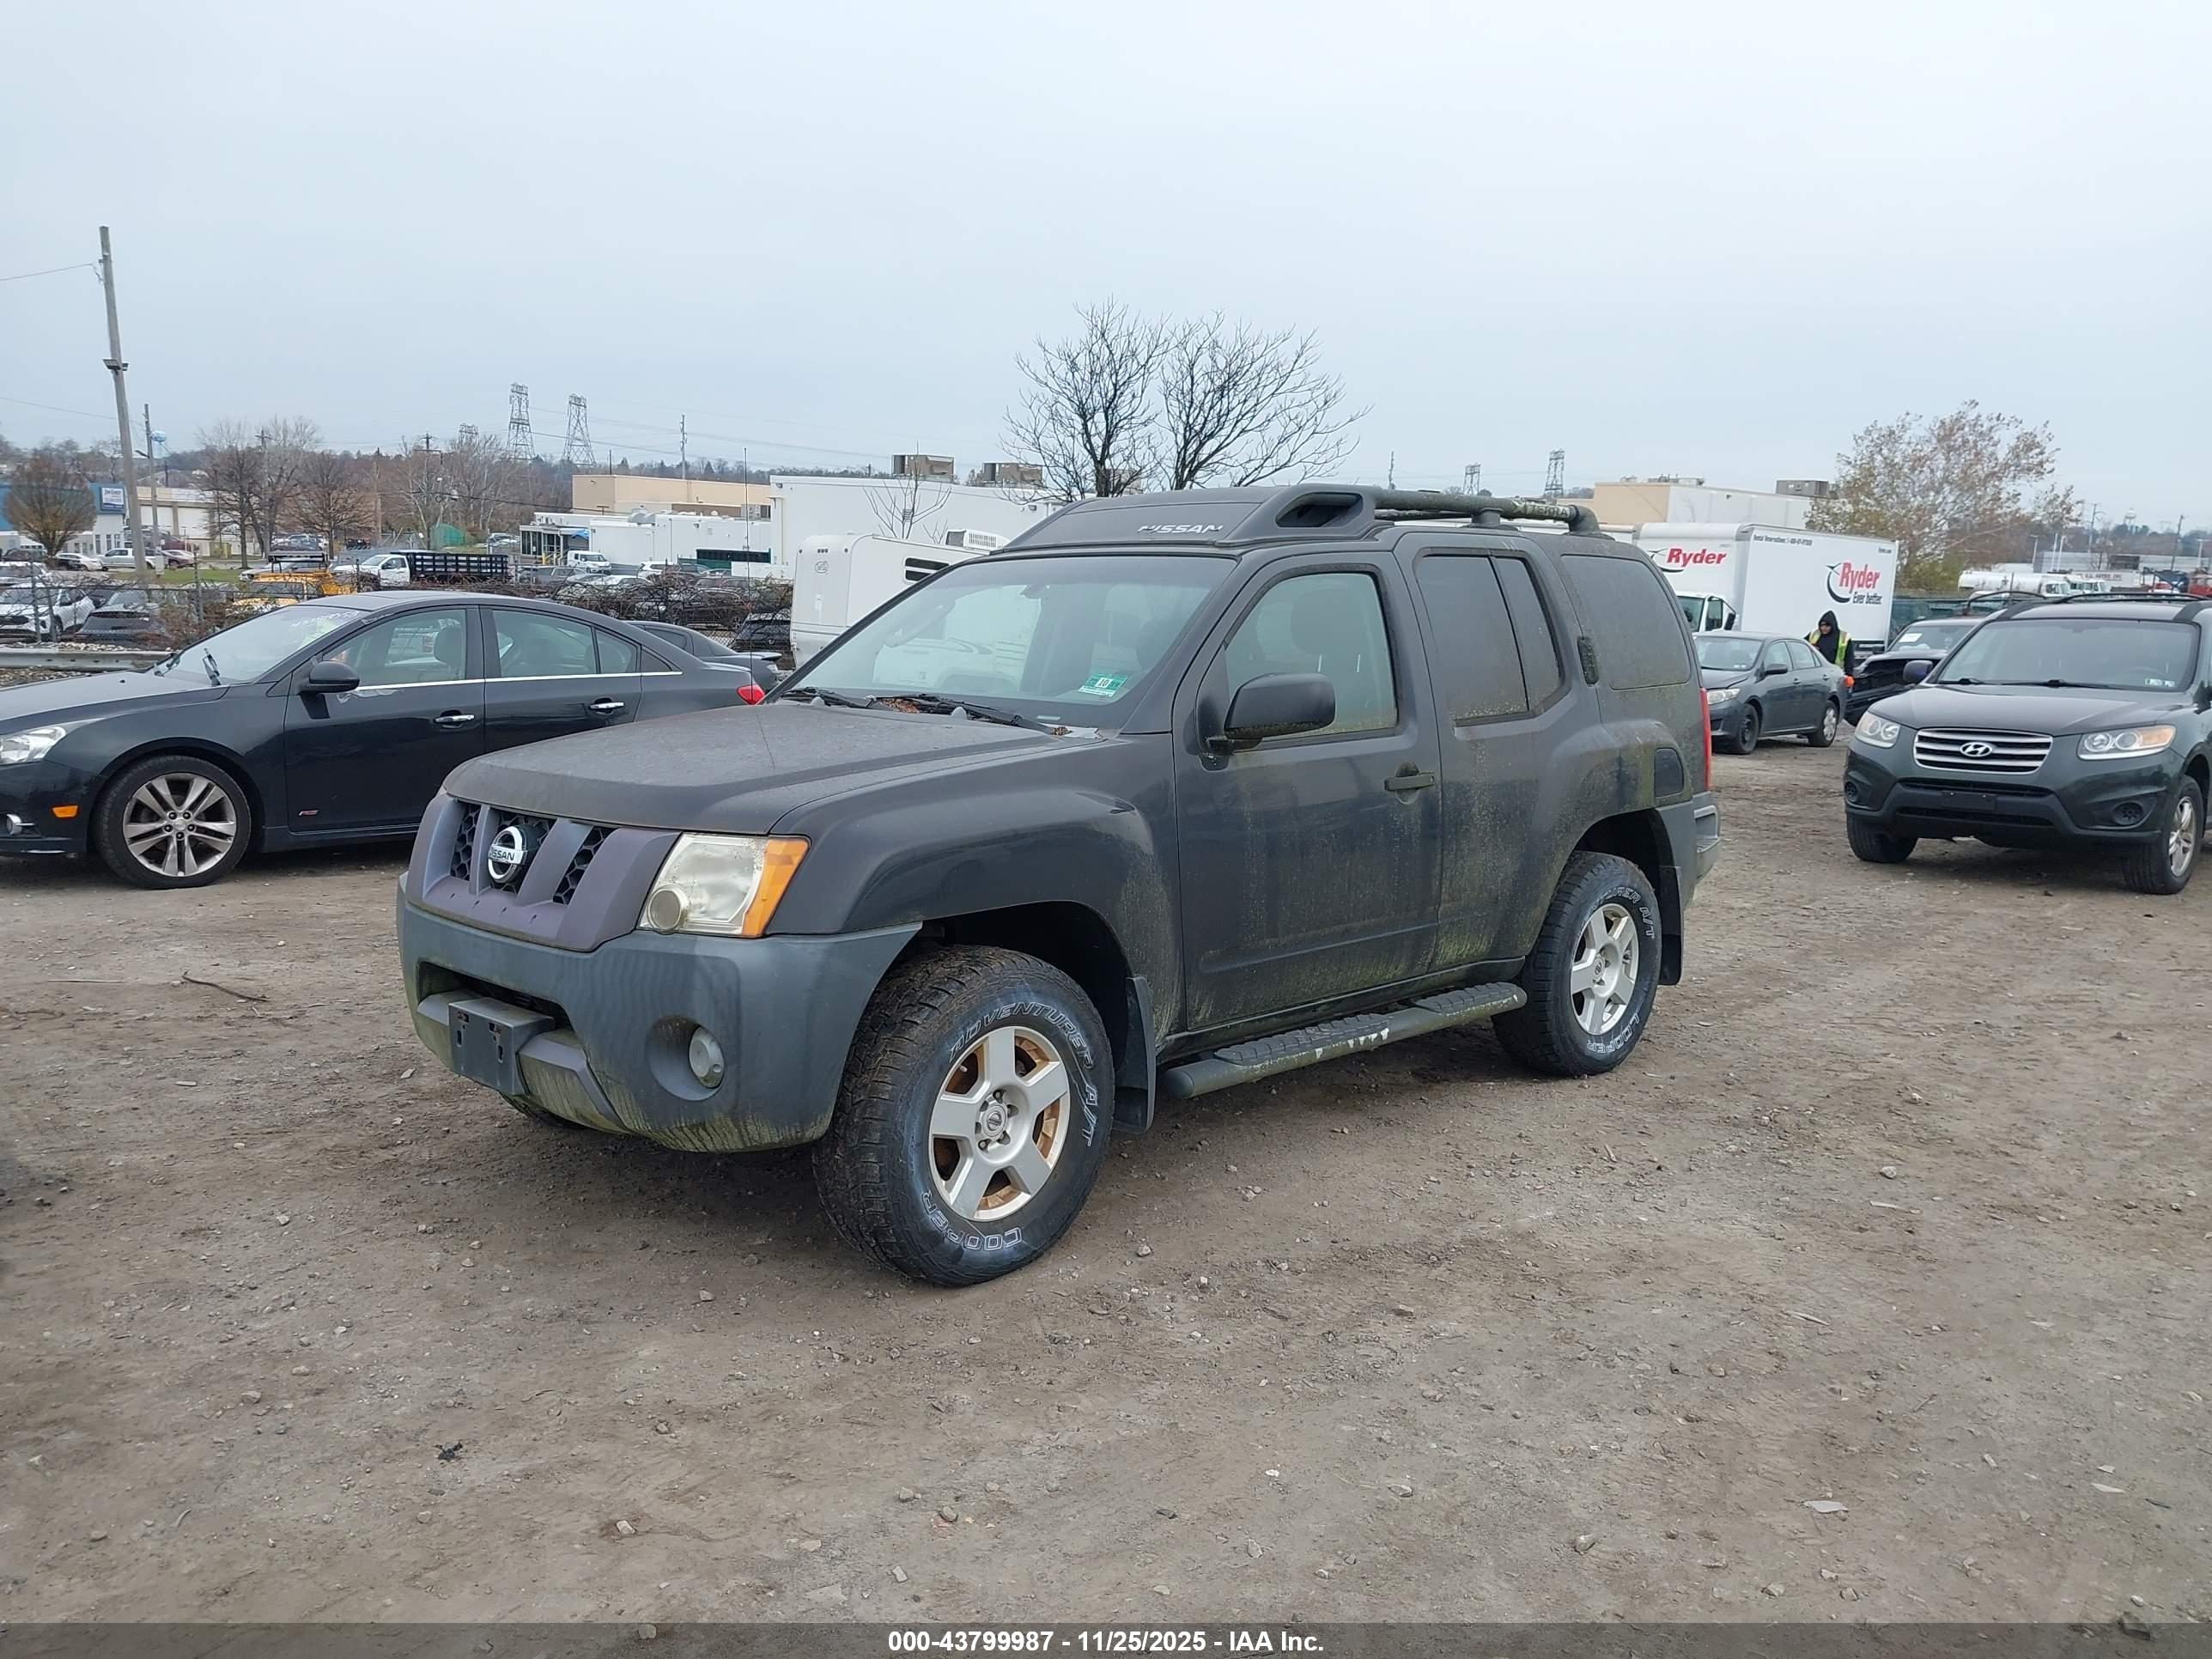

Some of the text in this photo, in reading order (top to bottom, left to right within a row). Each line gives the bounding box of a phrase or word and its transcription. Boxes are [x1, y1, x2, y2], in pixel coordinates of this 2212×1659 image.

[1137, 524, 1224, 533] NISSAN
[1666, 547, 1727, 568] Ryder
[1838, 562, 1881, 594] Ryder
[1098, 678, 1110, 687] 10
[1638, 906, 1656, 939] A/T
[948, 1000, 1094, 1070] ADVENTURER
[1586, 1013, 1640, 1054] COOPER
[921, 1188, 1023, 1251] COOPER
